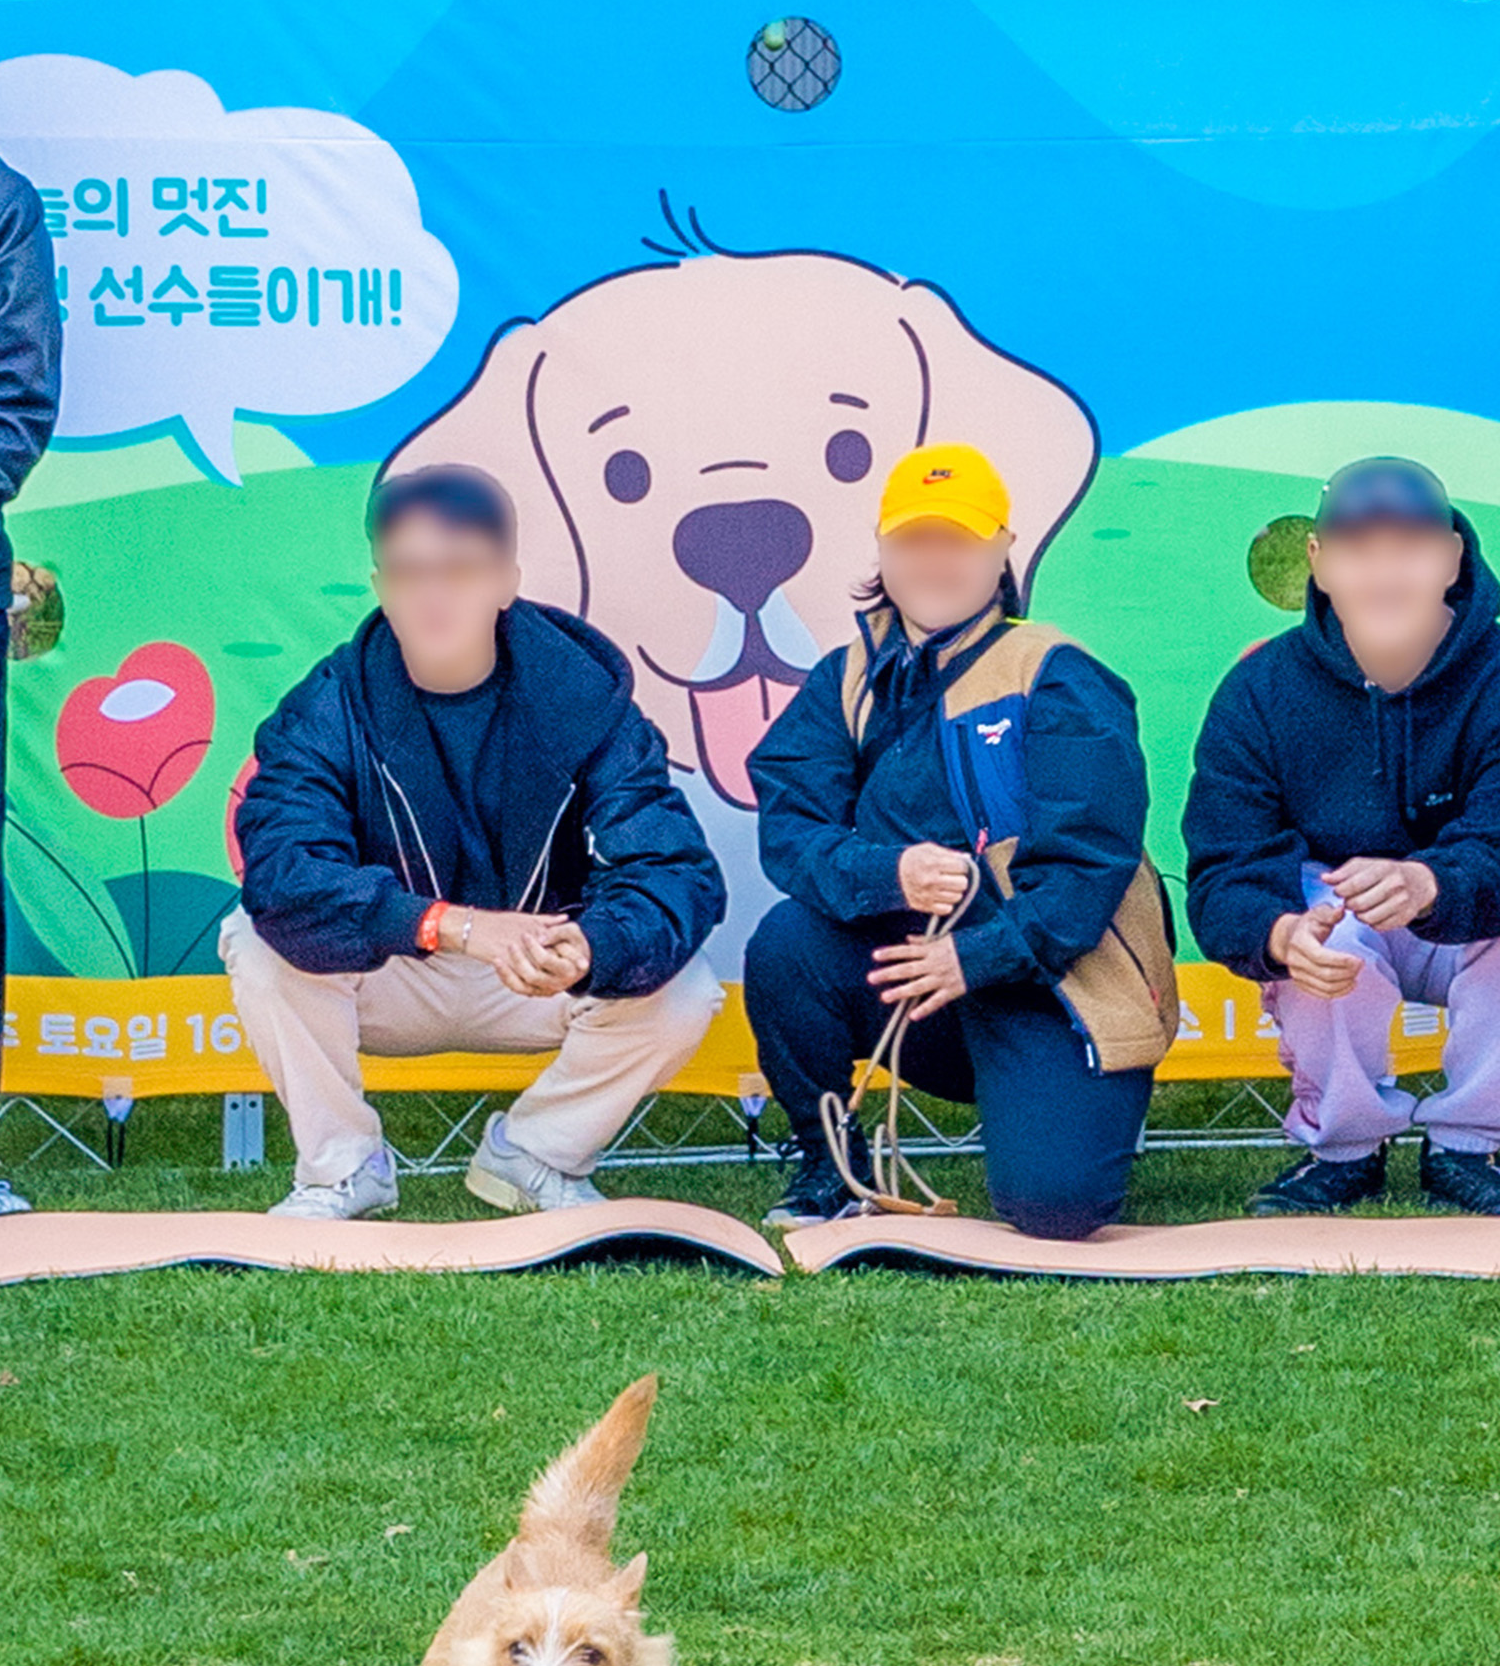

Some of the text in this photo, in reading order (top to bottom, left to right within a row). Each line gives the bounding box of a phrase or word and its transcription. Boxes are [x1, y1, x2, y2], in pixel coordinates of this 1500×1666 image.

[152, 177, 269, 238] 멋진
[89, 264, 402, 327] 선수들이개!
[37, 1013, 169, 1061] 토요일
